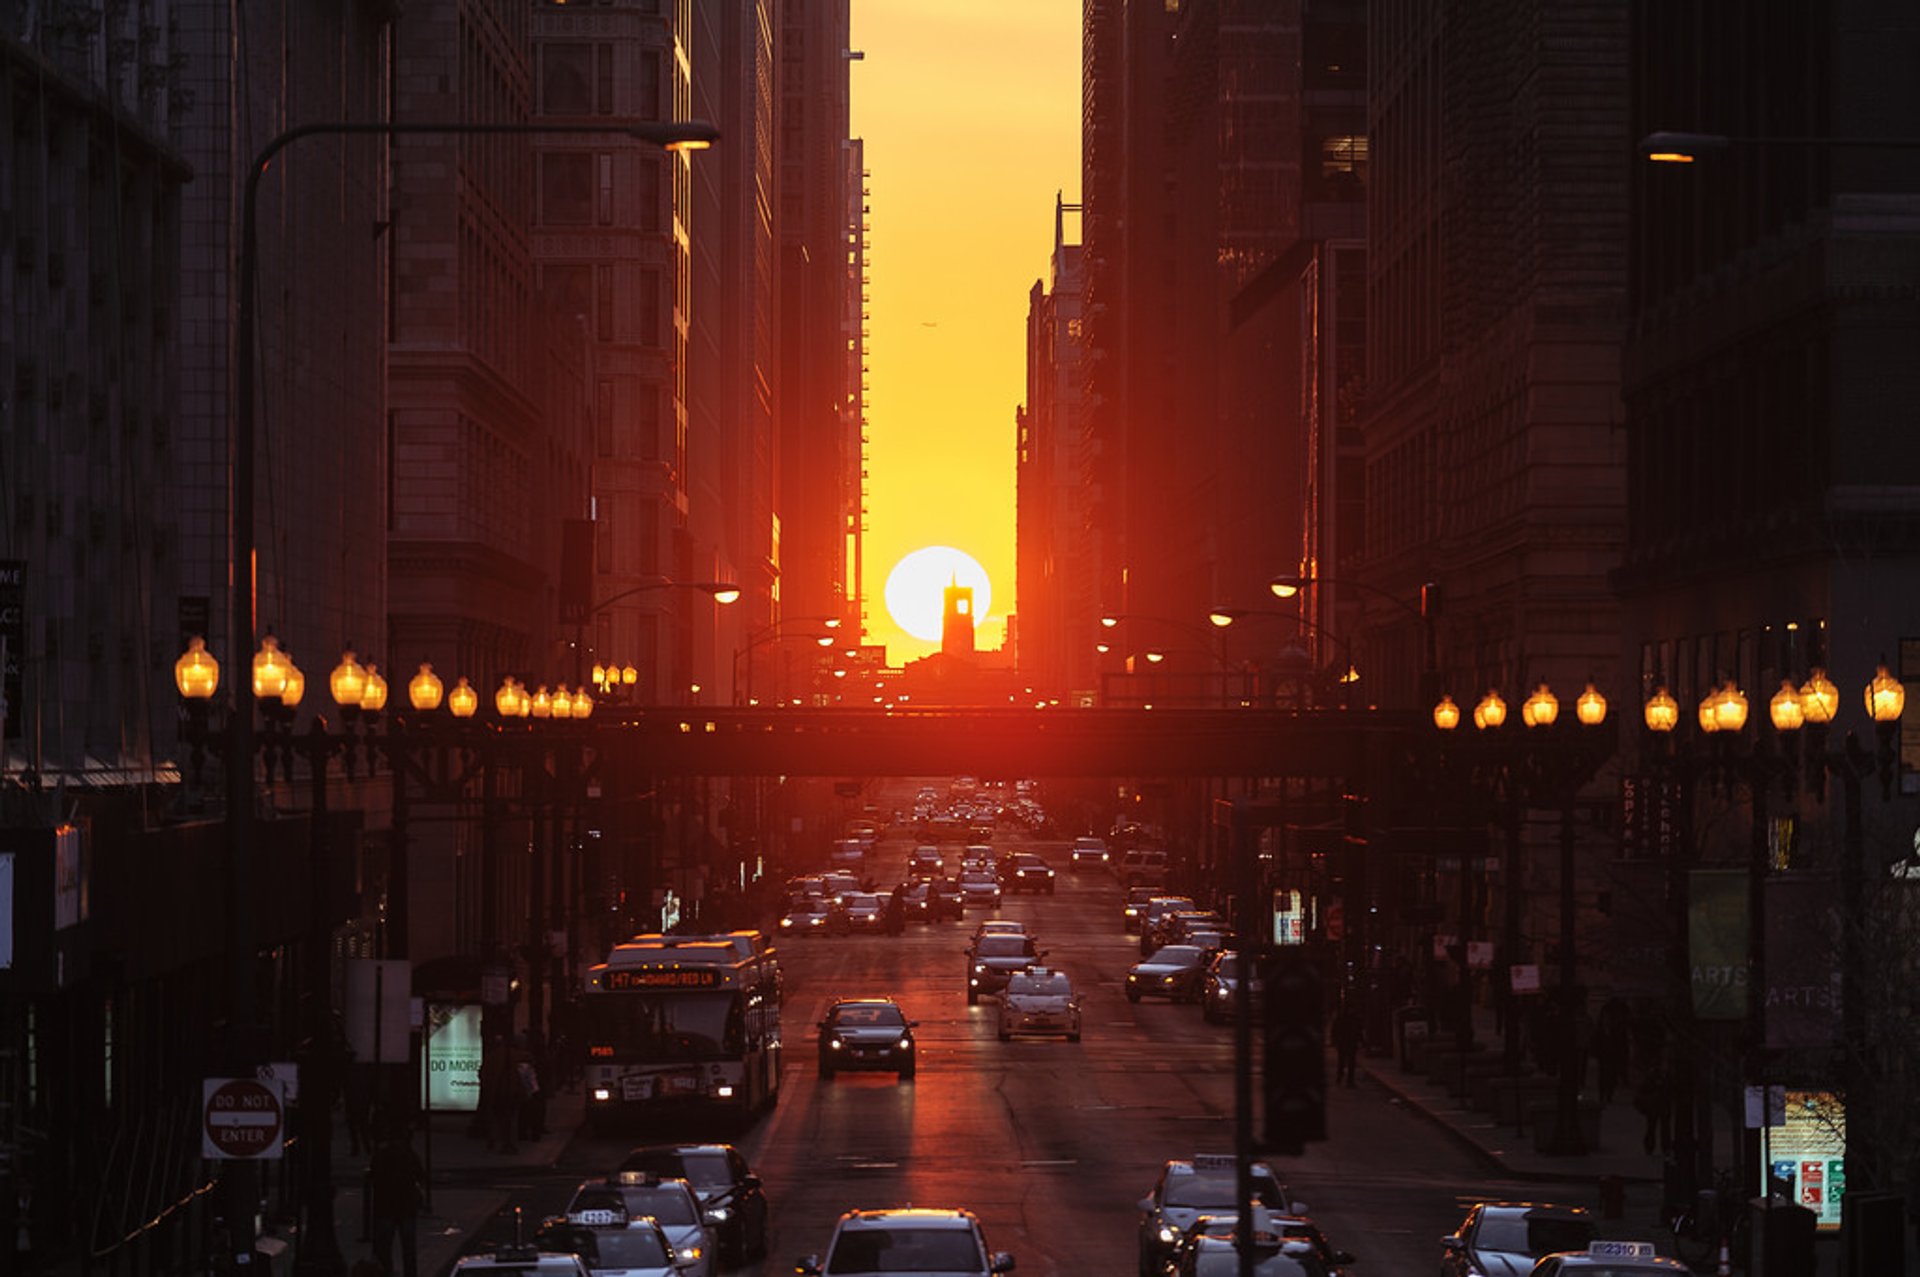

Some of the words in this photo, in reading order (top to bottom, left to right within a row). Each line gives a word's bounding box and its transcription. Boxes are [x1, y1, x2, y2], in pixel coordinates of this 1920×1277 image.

[1691, 965, 1748, 986] ARTS
[1764, 986, 1832, 1007] ARTS
[431, 1060, 446, 1072] DO
[448, 1060, 480, 1072] MORE
[215, 1094, 235, 1109] DO
[242, 1094, 270, 1109] NOT
[221, 1128, 265, 1143] ENTER
[1605, 1243, 1636, 1256] 2310
